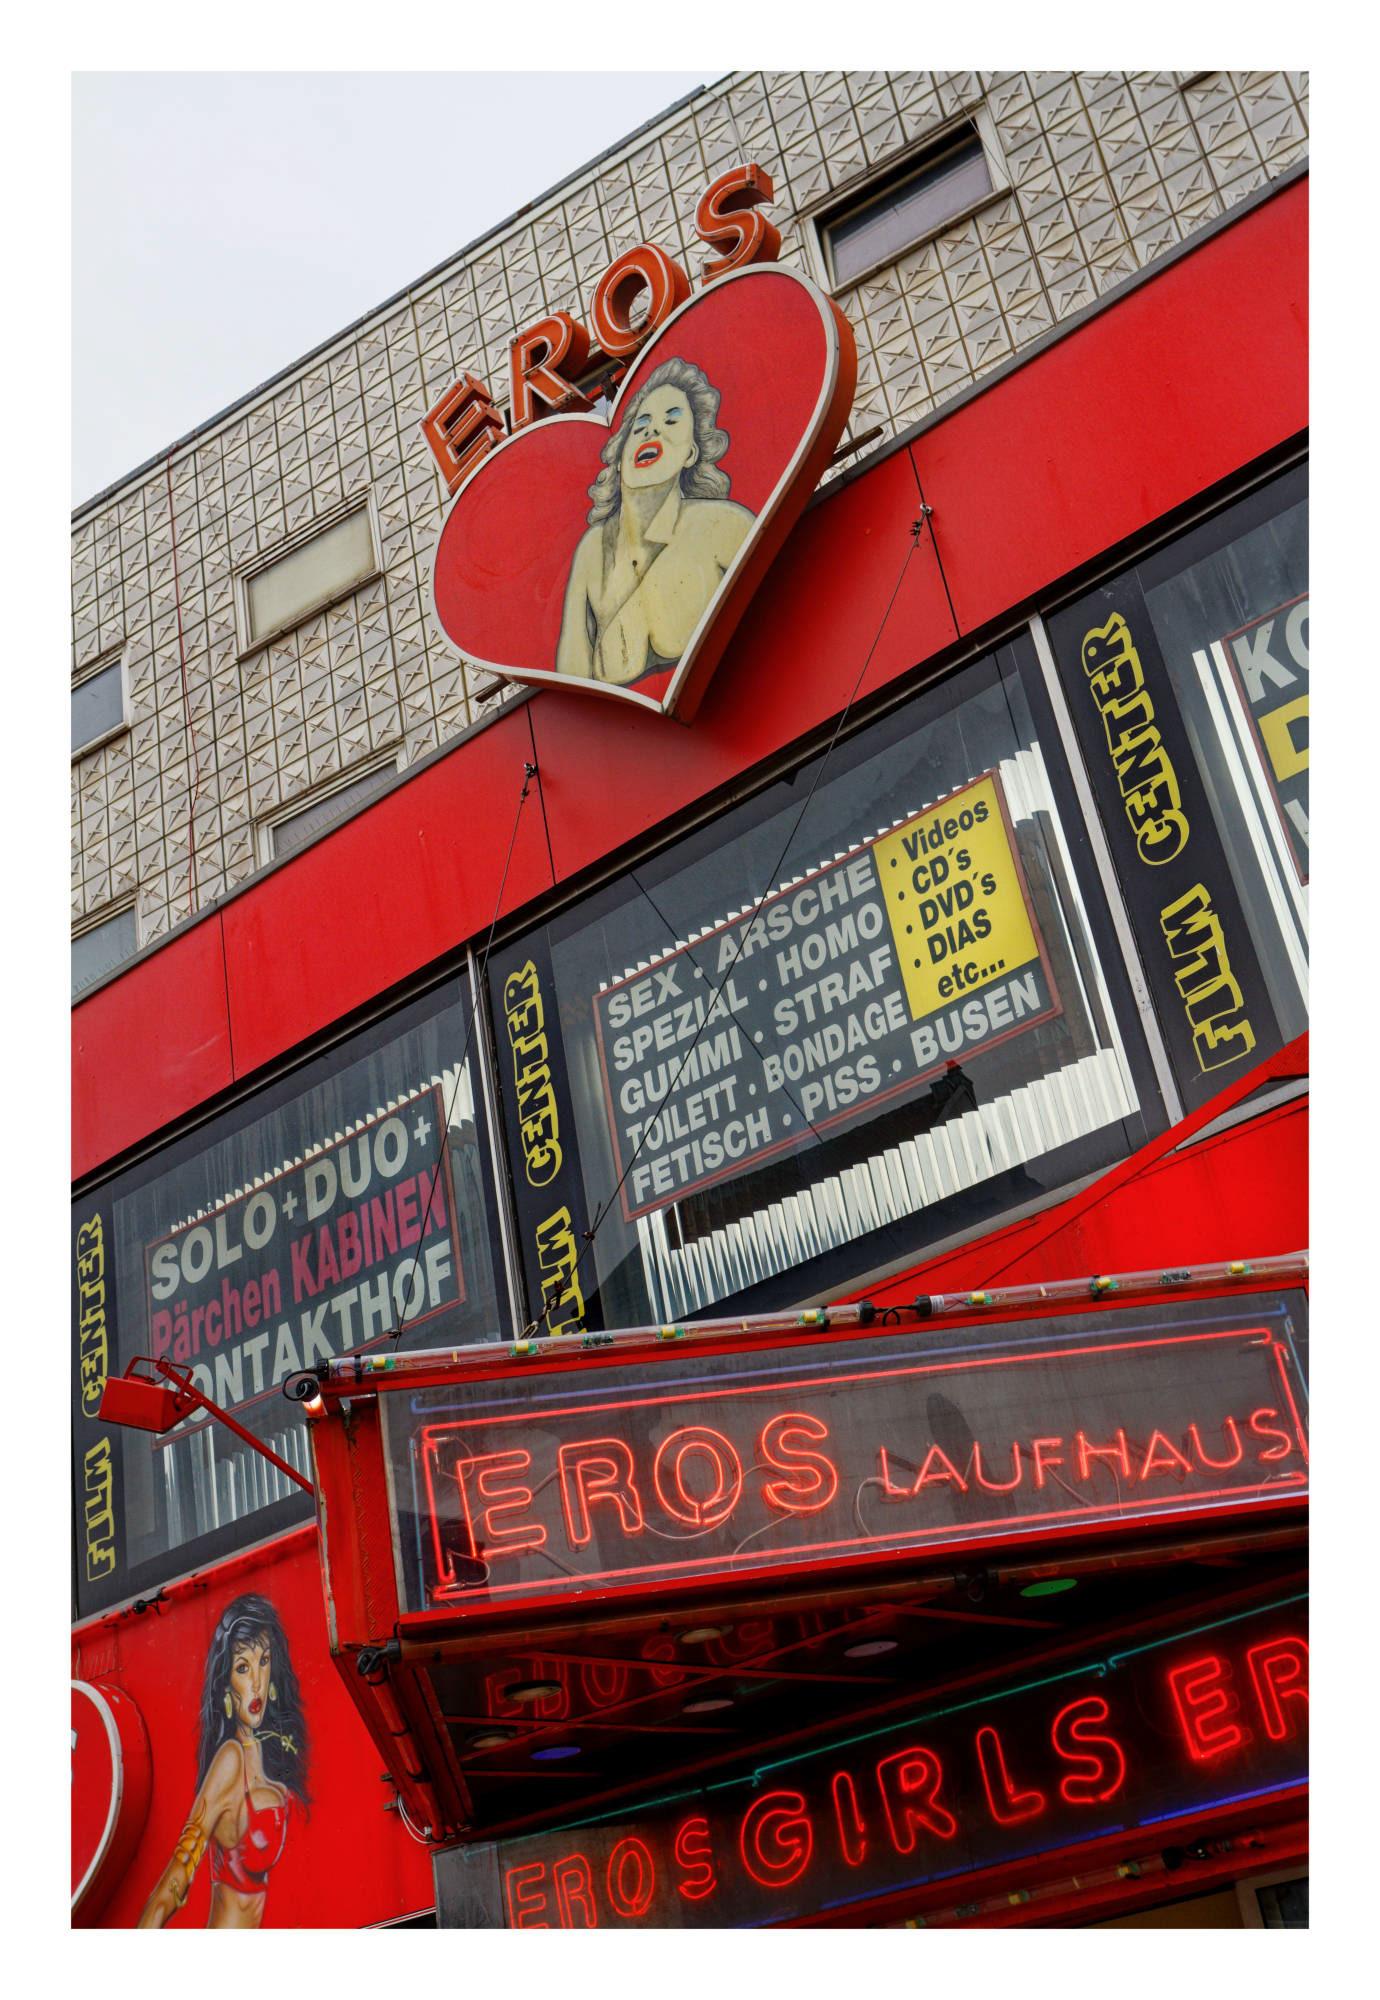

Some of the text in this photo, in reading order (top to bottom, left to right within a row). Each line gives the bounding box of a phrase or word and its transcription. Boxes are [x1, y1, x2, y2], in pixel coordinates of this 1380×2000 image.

[418, 162, 782, 497] EROS
[901, 800, 990, 863] Videos
[1081, 611, 1257, 1074] FILM CENTER
[607, 854, 877, 1029] SEX ARSCHE
[612, 902, 883, 1072] SPEZIAL HOMO
[926, 908, 993, 965] DIAS
[937, 958, 1006, 999] etc...
[504, 959, 563, 1188] CENTER
[619, 944, 893, 1115] GUMMI STRAF
[625, 990, 908, 1160] TOILETT BONDAGE
[631, 971, 1041, 1205] FETISCH PISS BUSEN
[151, 1190, 277, 1301] SOLO
[303, 1117, 409, 1222] DUO
[152, 1163, 448, 1374] Pärchen KABINEN
[76, 1212, 116, 1582] FILM CENTER
[155, 1238, 452, 1439] ONTAKTHOF
[456, 1408, 1292, 1560] EROS LAUFHAUS
[505, 1817, 717, 1929] EROS
[740, 1695, 1128, 1887] GIRLS
